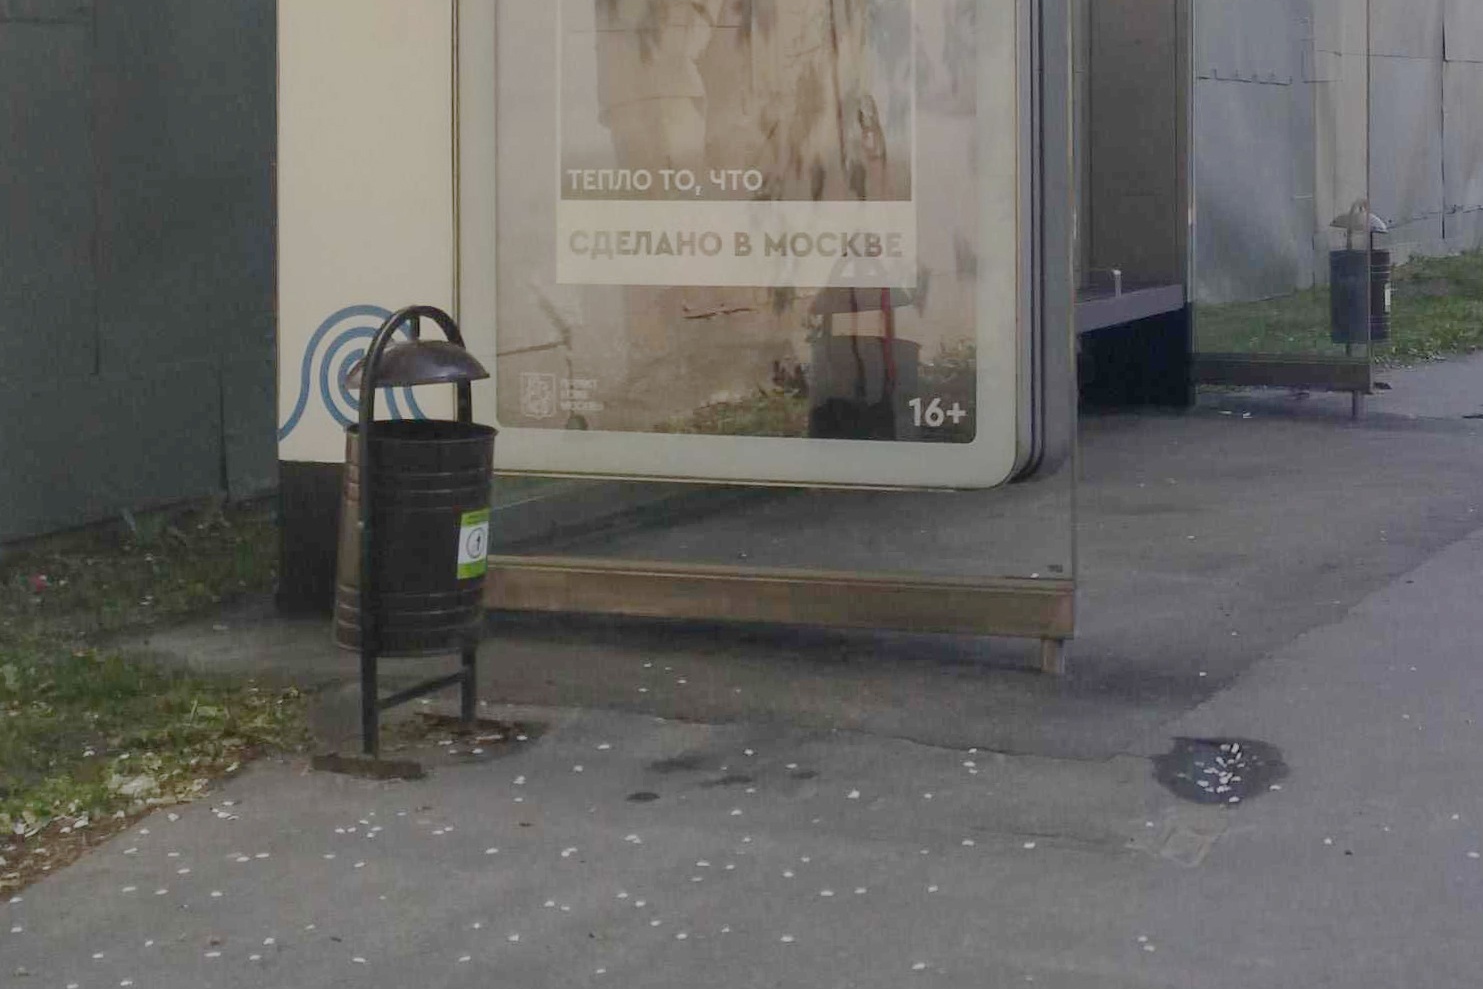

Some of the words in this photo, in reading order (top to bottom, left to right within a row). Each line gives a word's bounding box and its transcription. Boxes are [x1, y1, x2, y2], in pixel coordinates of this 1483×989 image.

[568, 169, 653, 191] ТЕПЛО
[658, 169, 702, 196] ТО,
[710, 168, 764, 190] ЧТО
[569, 229, 723, 261] СДЕЛАНО
[733, 231, 753, 258] В
[764, 231, 904, 259] МОСКВЕ
[909, 397, 967, 428] 16+
